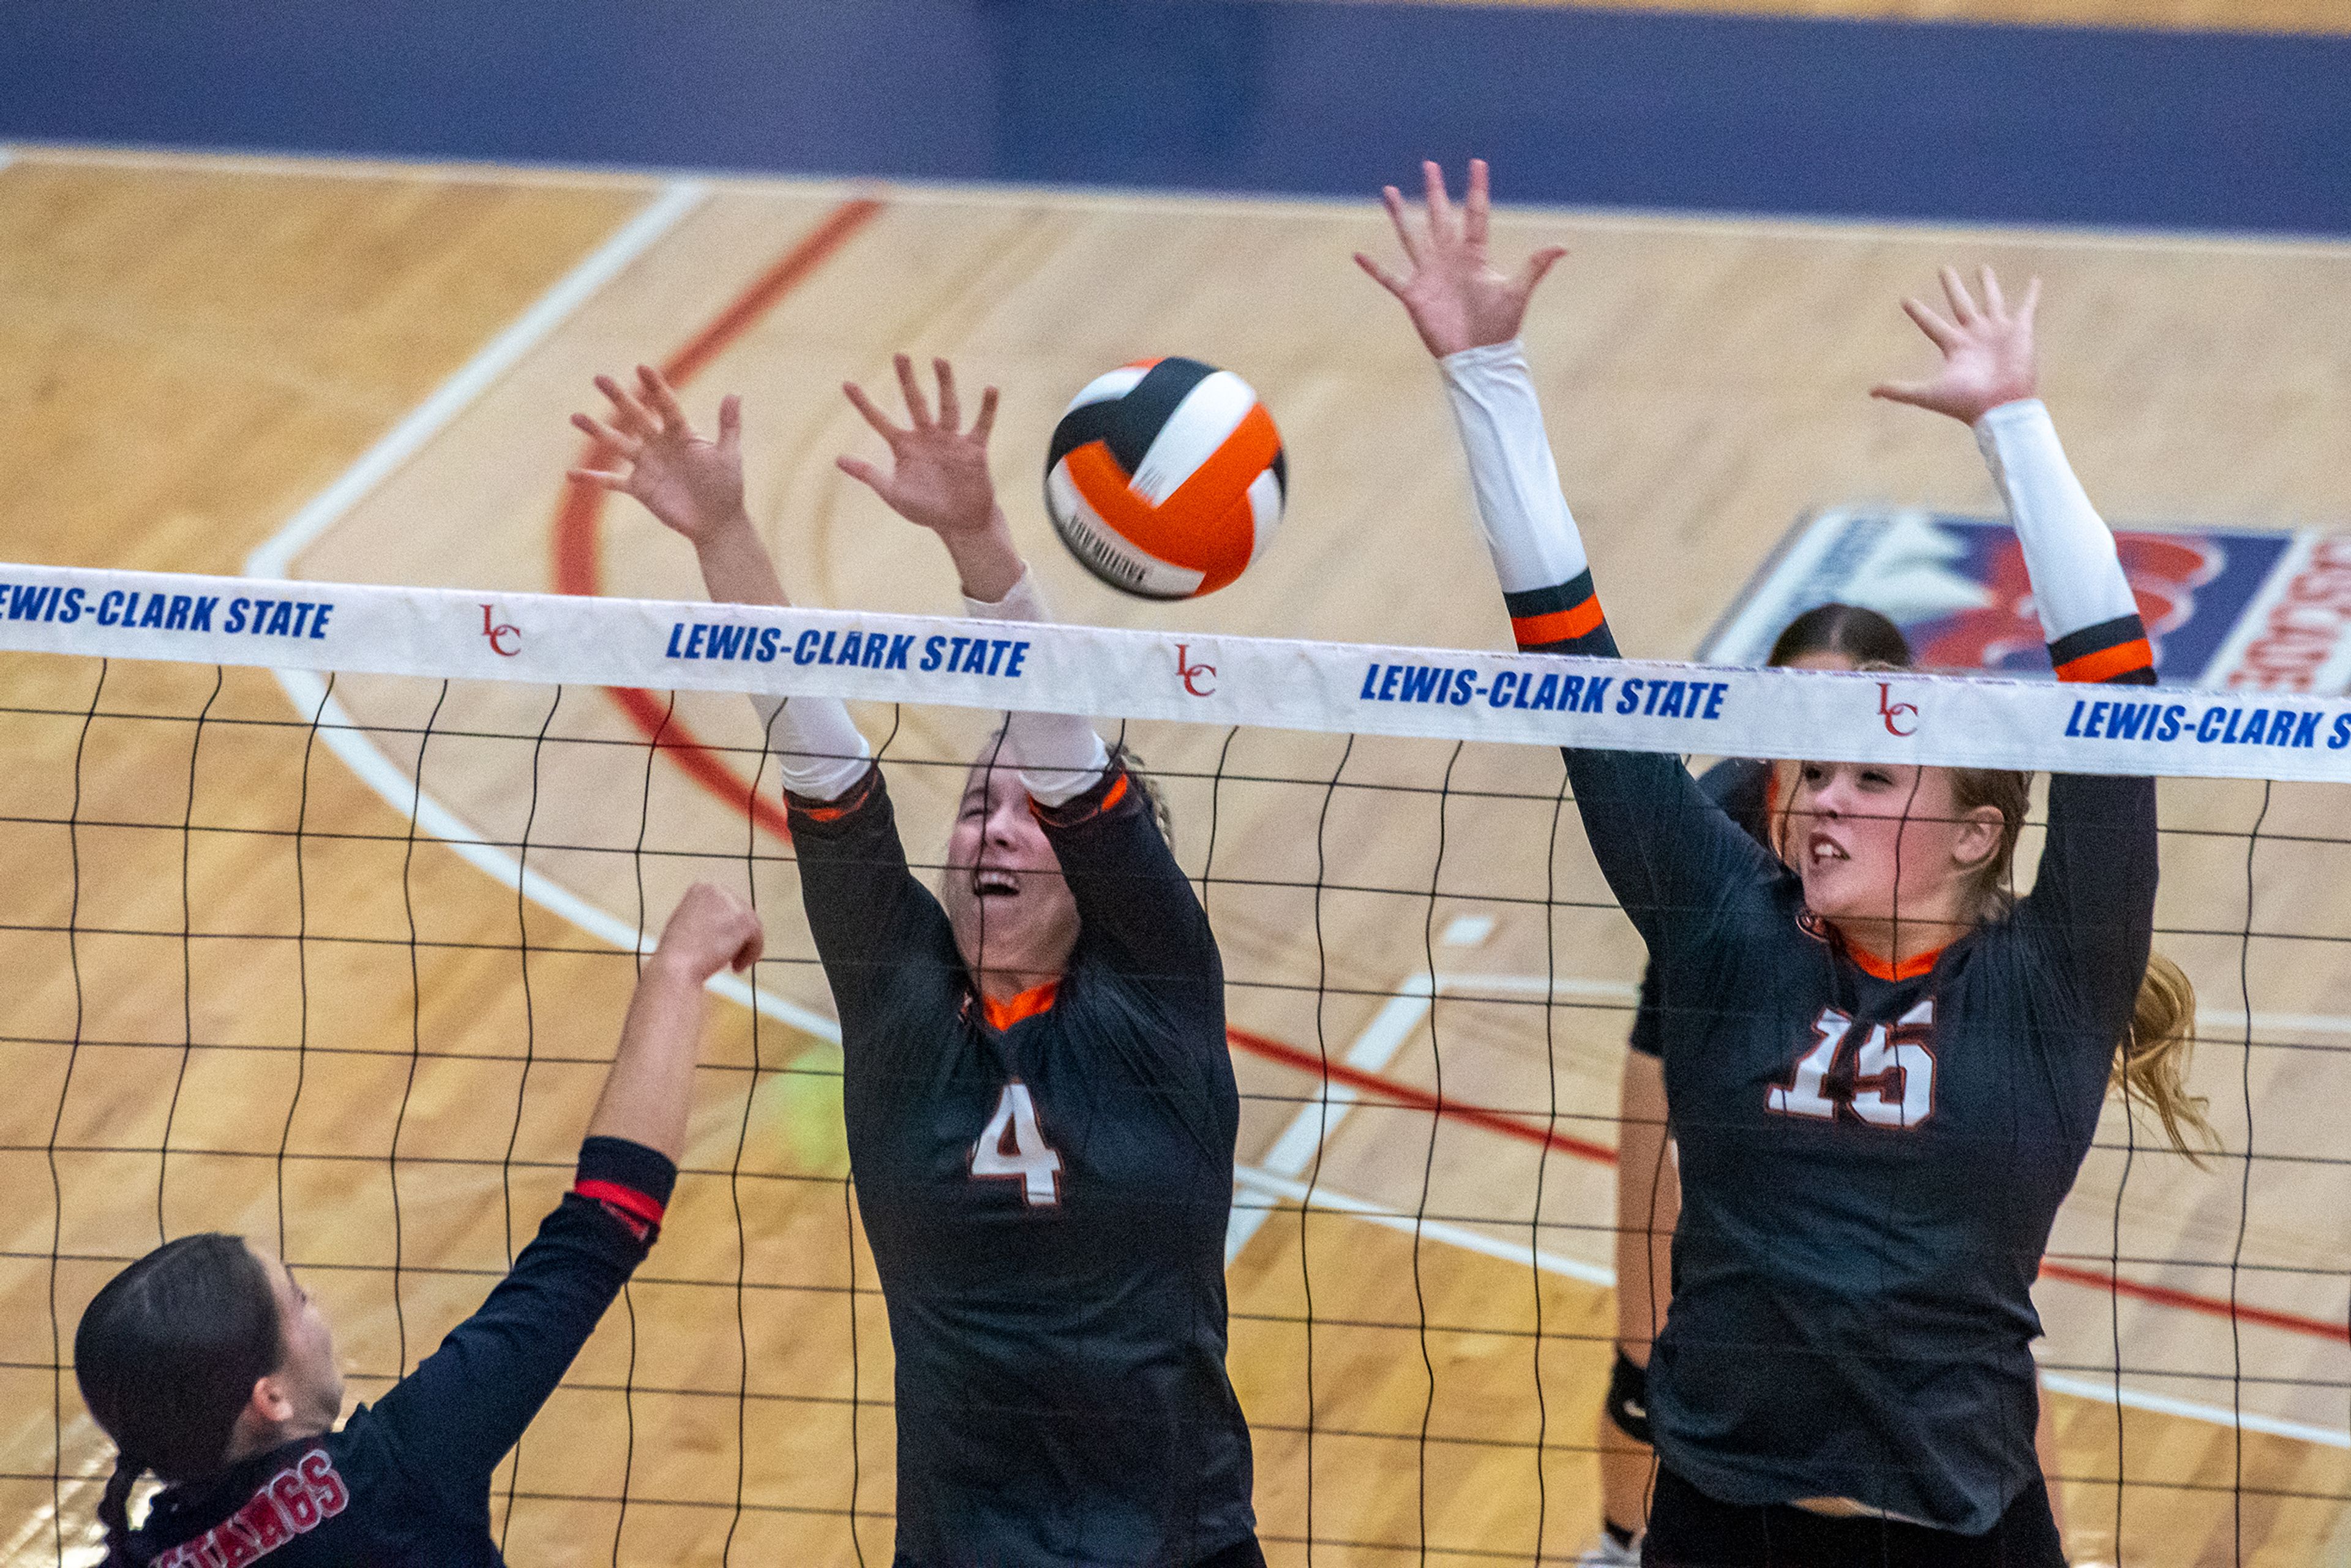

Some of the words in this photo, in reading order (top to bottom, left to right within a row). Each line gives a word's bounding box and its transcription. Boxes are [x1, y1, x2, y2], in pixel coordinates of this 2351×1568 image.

[224, 598, 334, 639] STATE
[666, 623, 915, 670] LEWIS-CLARK
[920, 636, 1030, 678] STATE
[1360, 664, 1613, 714] LEWIS-CLARK
[1616, 678, 1728, 720] STATE
[2064, 700, 2324, 748] LEWIS-CLARK
[1766, 997, 1937, 1130] 15
[967, 1076, 1063, 1206] 4
